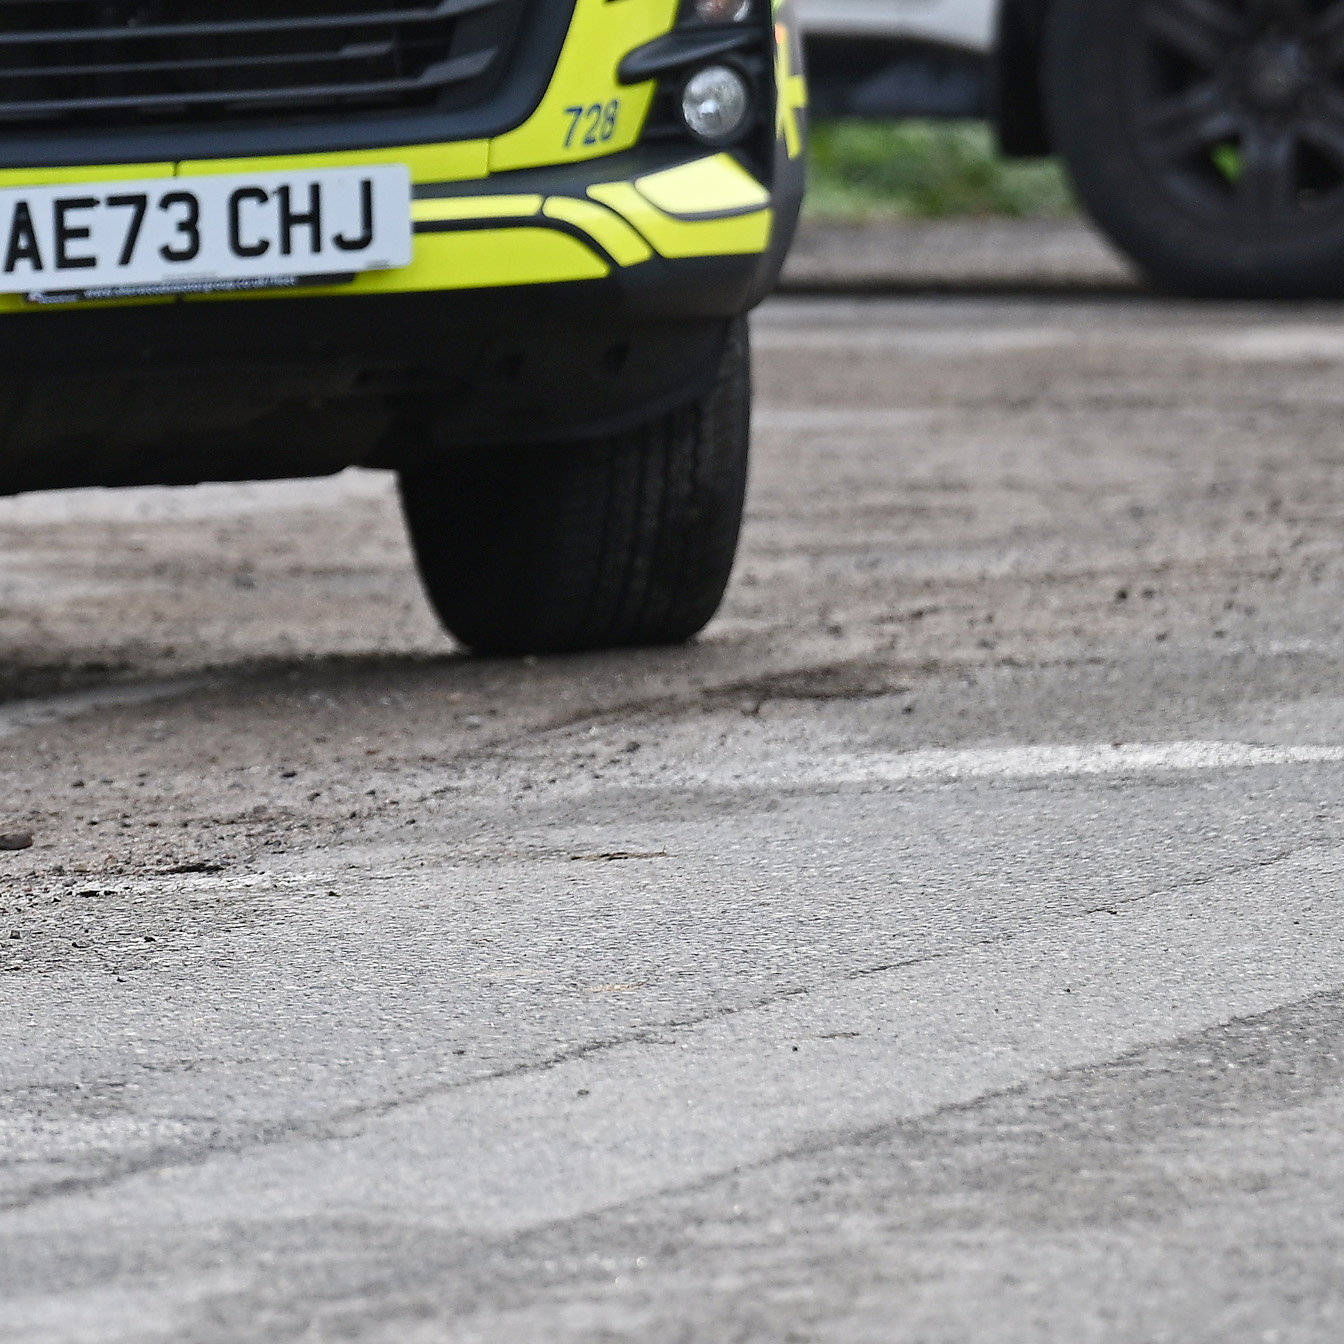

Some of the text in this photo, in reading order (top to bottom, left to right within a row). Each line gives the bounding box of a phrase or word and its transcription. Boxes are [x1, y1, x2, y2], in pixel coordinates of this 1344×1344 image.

[564, 99, 619, 149] 728
[3, 179, 374, 273] AE73 CHJ
